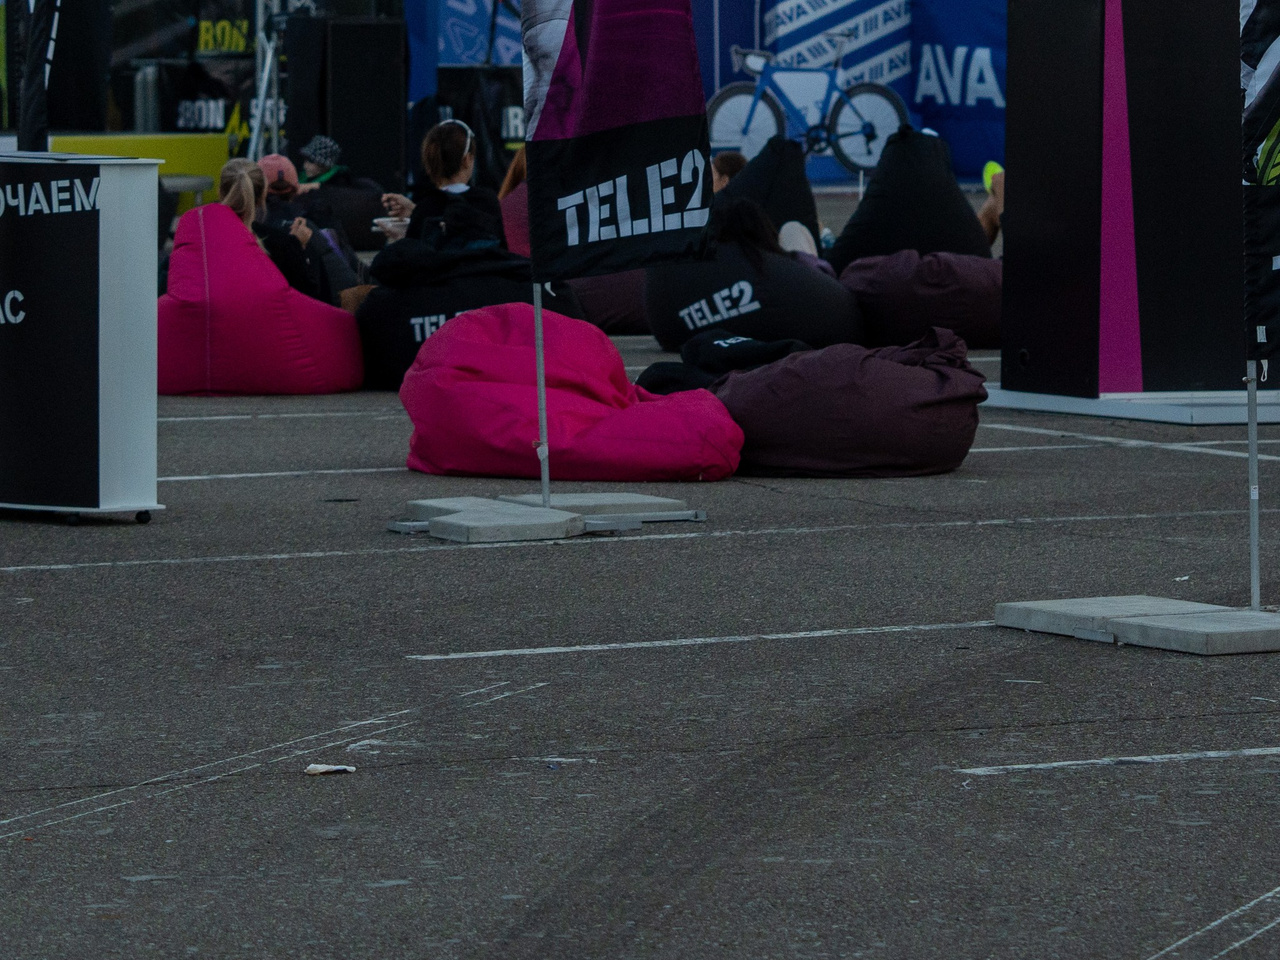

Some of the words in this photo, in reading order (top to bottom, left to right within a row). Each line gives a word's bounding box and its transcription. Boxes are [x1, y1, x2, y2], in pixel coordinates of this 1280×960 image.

[914, 43, 1006, 109] AVA
[0, 177, 100, 218] ЧАЕМ
[557, 149, 709, 246] TELE2
[679, 280, 761, 331] TELE2
